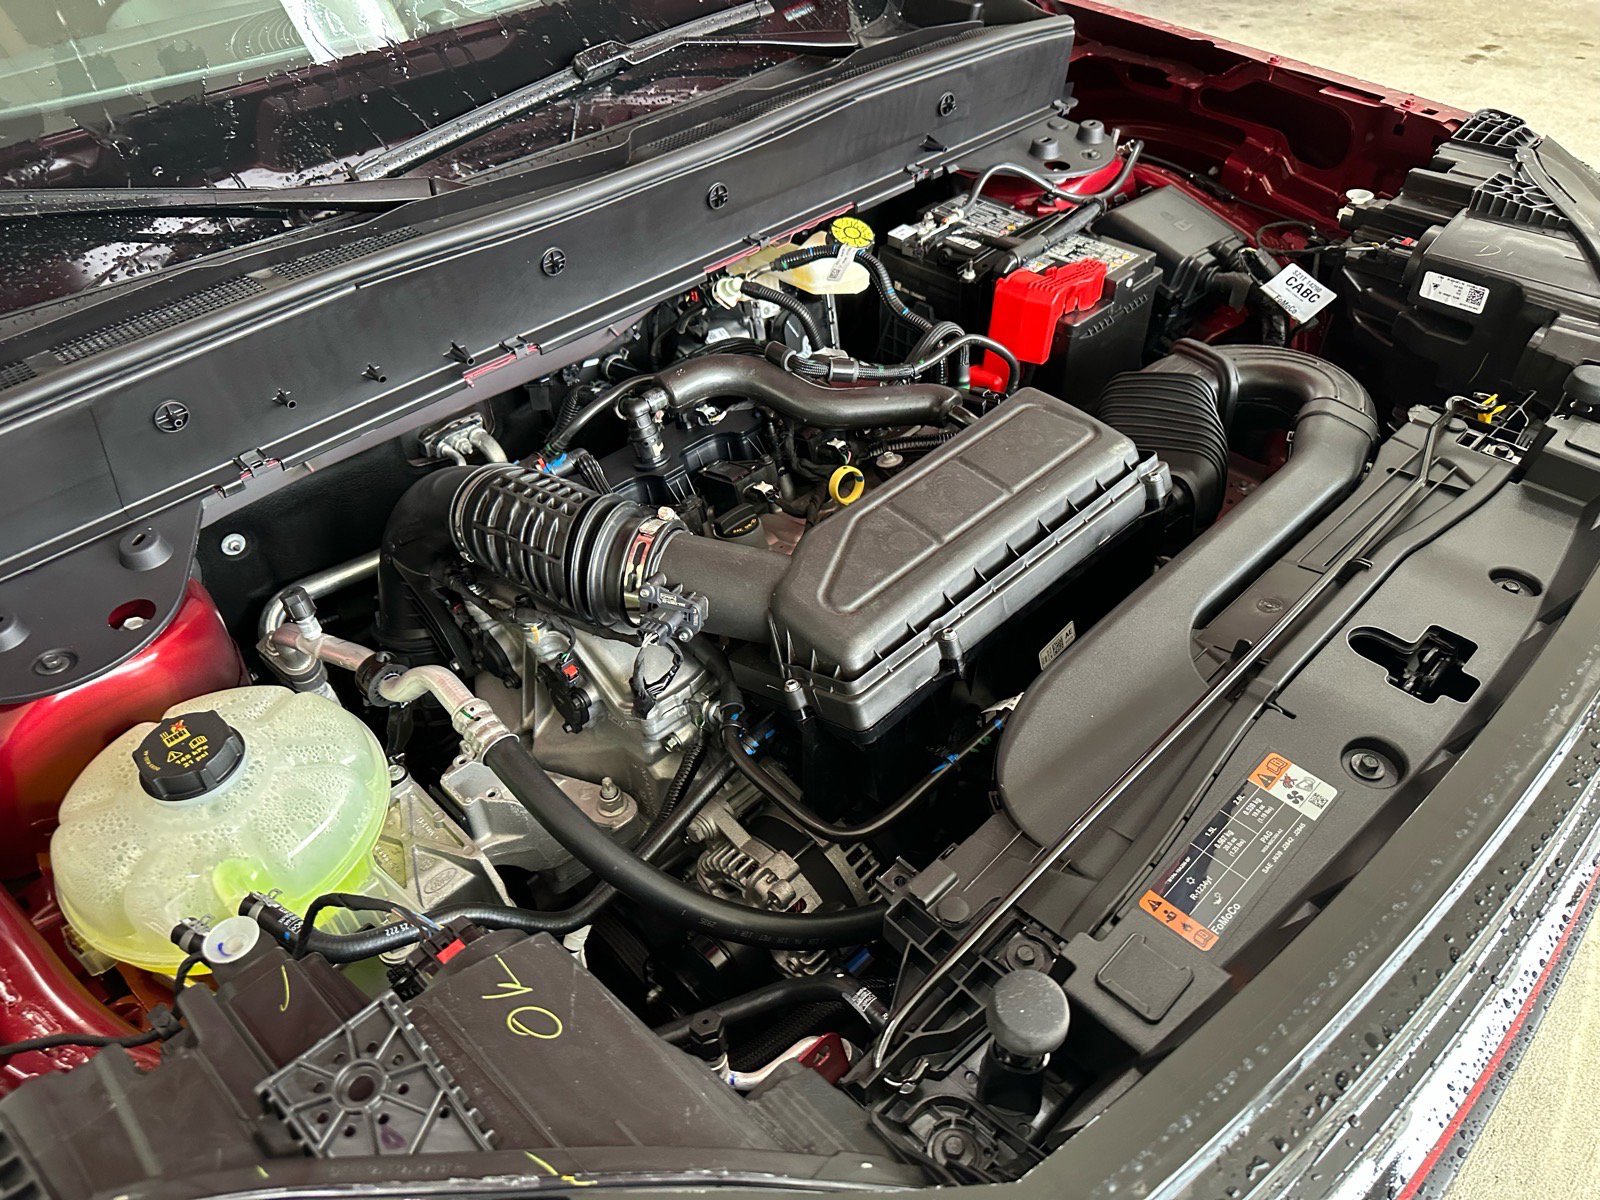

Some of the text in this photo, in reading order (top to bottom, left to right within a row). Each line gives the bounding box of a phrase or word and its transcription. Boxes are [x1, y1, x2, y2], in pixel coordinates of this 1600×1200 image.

[1285, 276, 1321, 304] CABC
[1274, 294, 1298, 314] FoMoCo
[175, 745, 209, 765] 145 kPa
[182, 751, 209, 769] 21 psi
[1232, 794, 1246, 806] 2.0L
[1252, 797, 1263, 805] kg
[1204, 826, 1218, 837] 1.5L
[1224, 829, 1235, 838] kg
[1259, 830, 1274, 844] PAG
[1261, 862, 1274, 874] SAE
[1189, 875, 1213, 901] R-1234yf
[1210, 903, 1241, 935] FoMoCo
